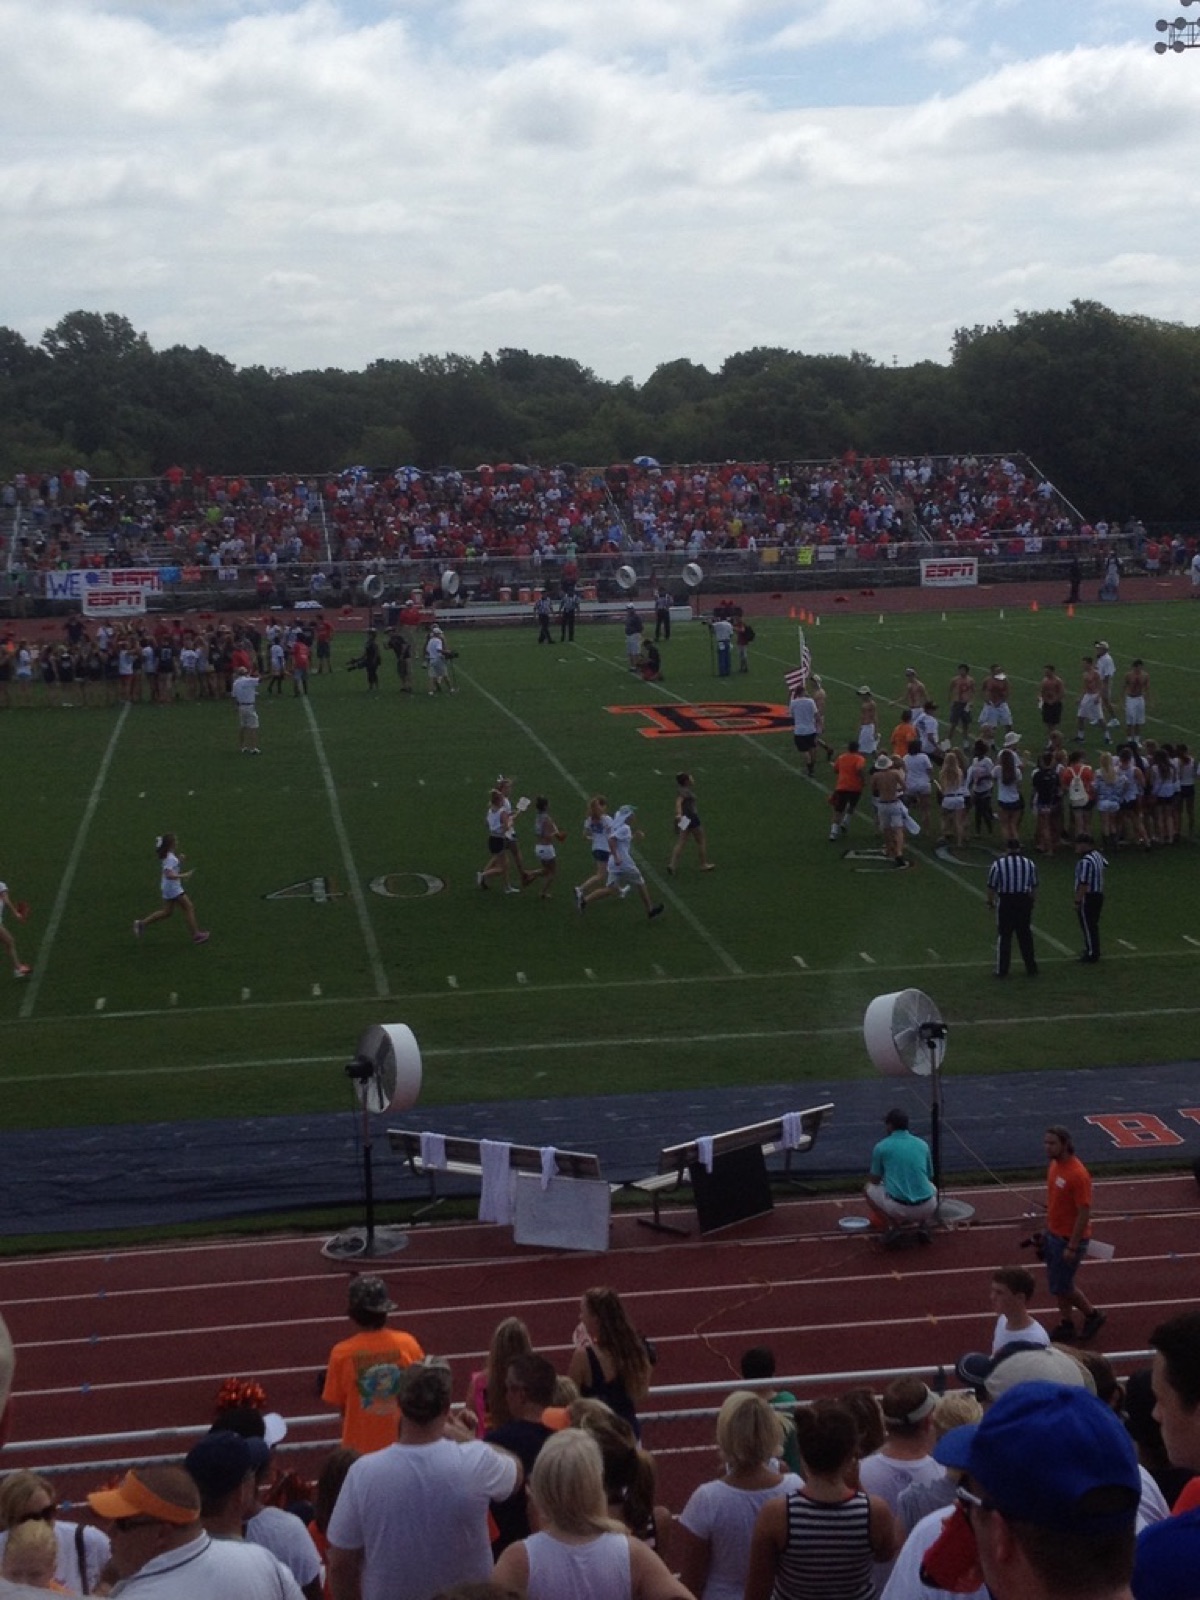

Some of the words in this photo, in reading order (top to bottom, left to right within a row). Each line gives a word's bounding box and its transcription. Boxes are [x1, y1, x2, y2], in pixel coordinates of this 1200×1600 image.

[925, 563, 974, 578] ESPN
[48, 573, 81, 598] WE
[87, 591, 142, 607] ESPN
[601, 702, 794, 738] B
